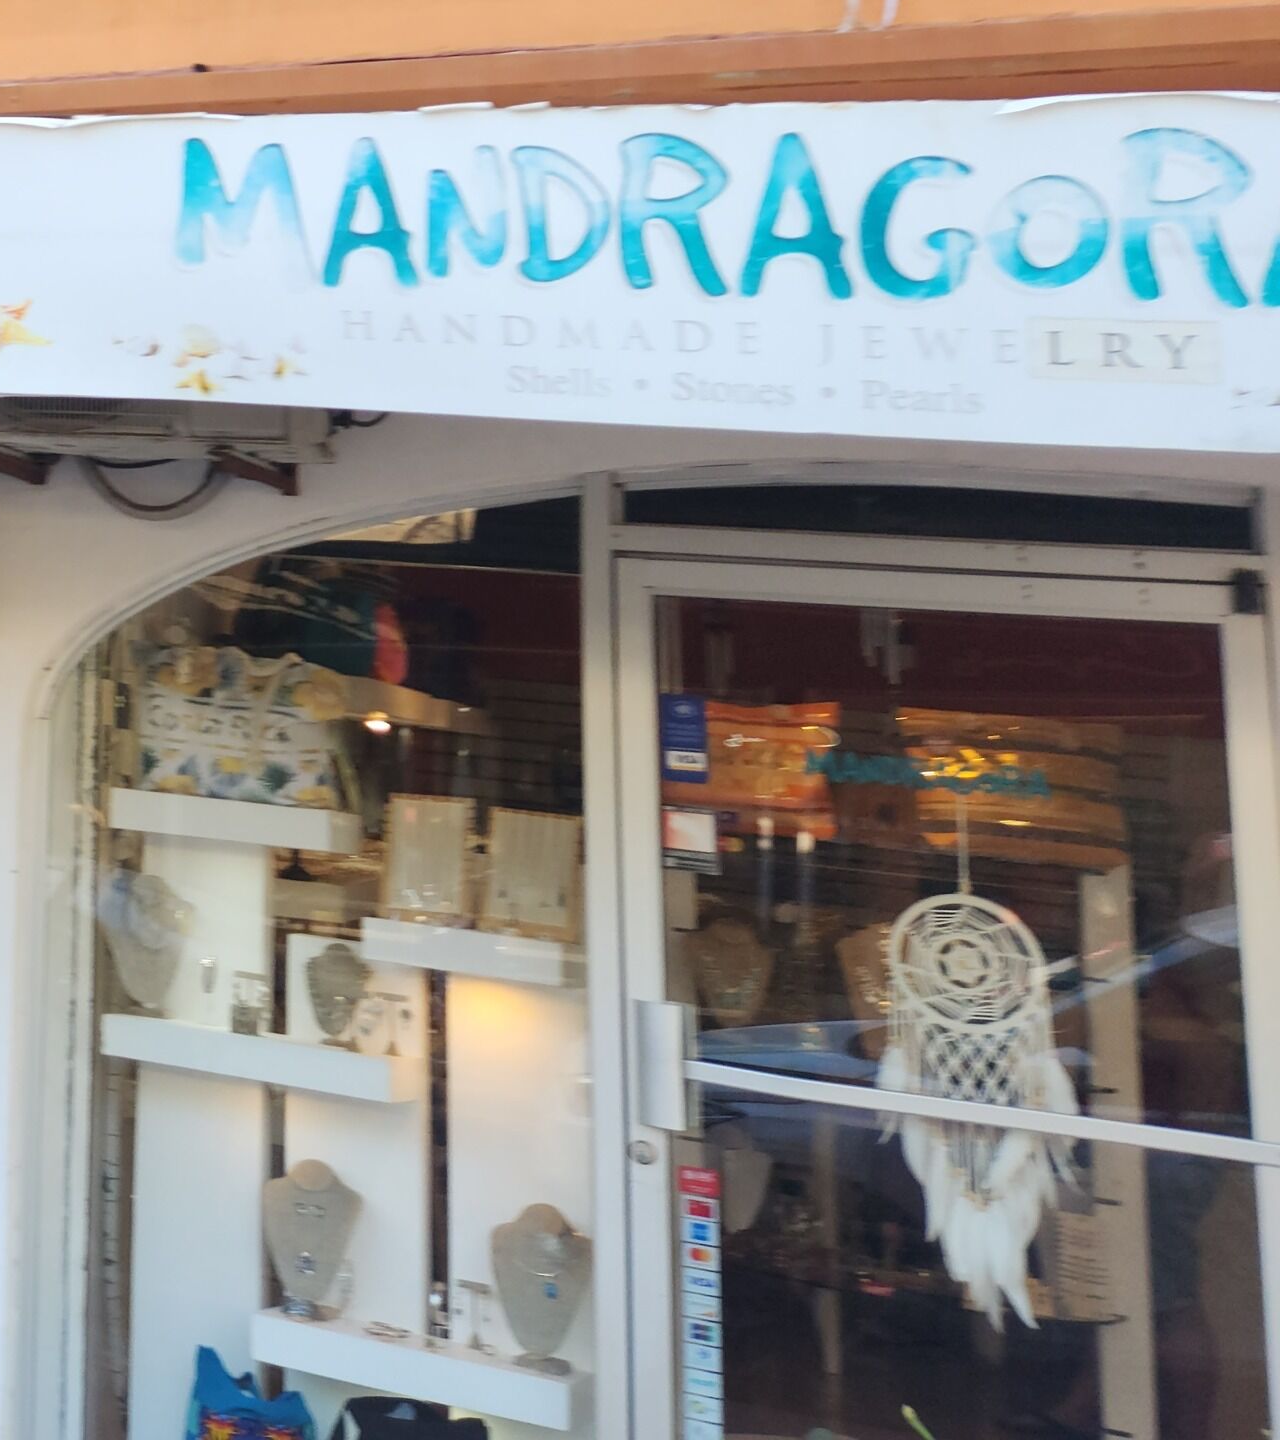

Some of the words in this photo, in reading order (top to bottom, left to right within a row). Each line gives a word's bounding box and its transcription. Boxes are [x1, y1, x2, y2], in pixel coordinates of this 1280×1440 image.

[173, 126, 1280, 310] MANDRAGOR
[341, 309, 761, 357] HANDMADE
[816, 322, 1201, 370] JEWELRY
[506, 364, 613, 400] Shells
[671, 371, 796, 406] Stones
[859, 378, 987, 415] Pearls
